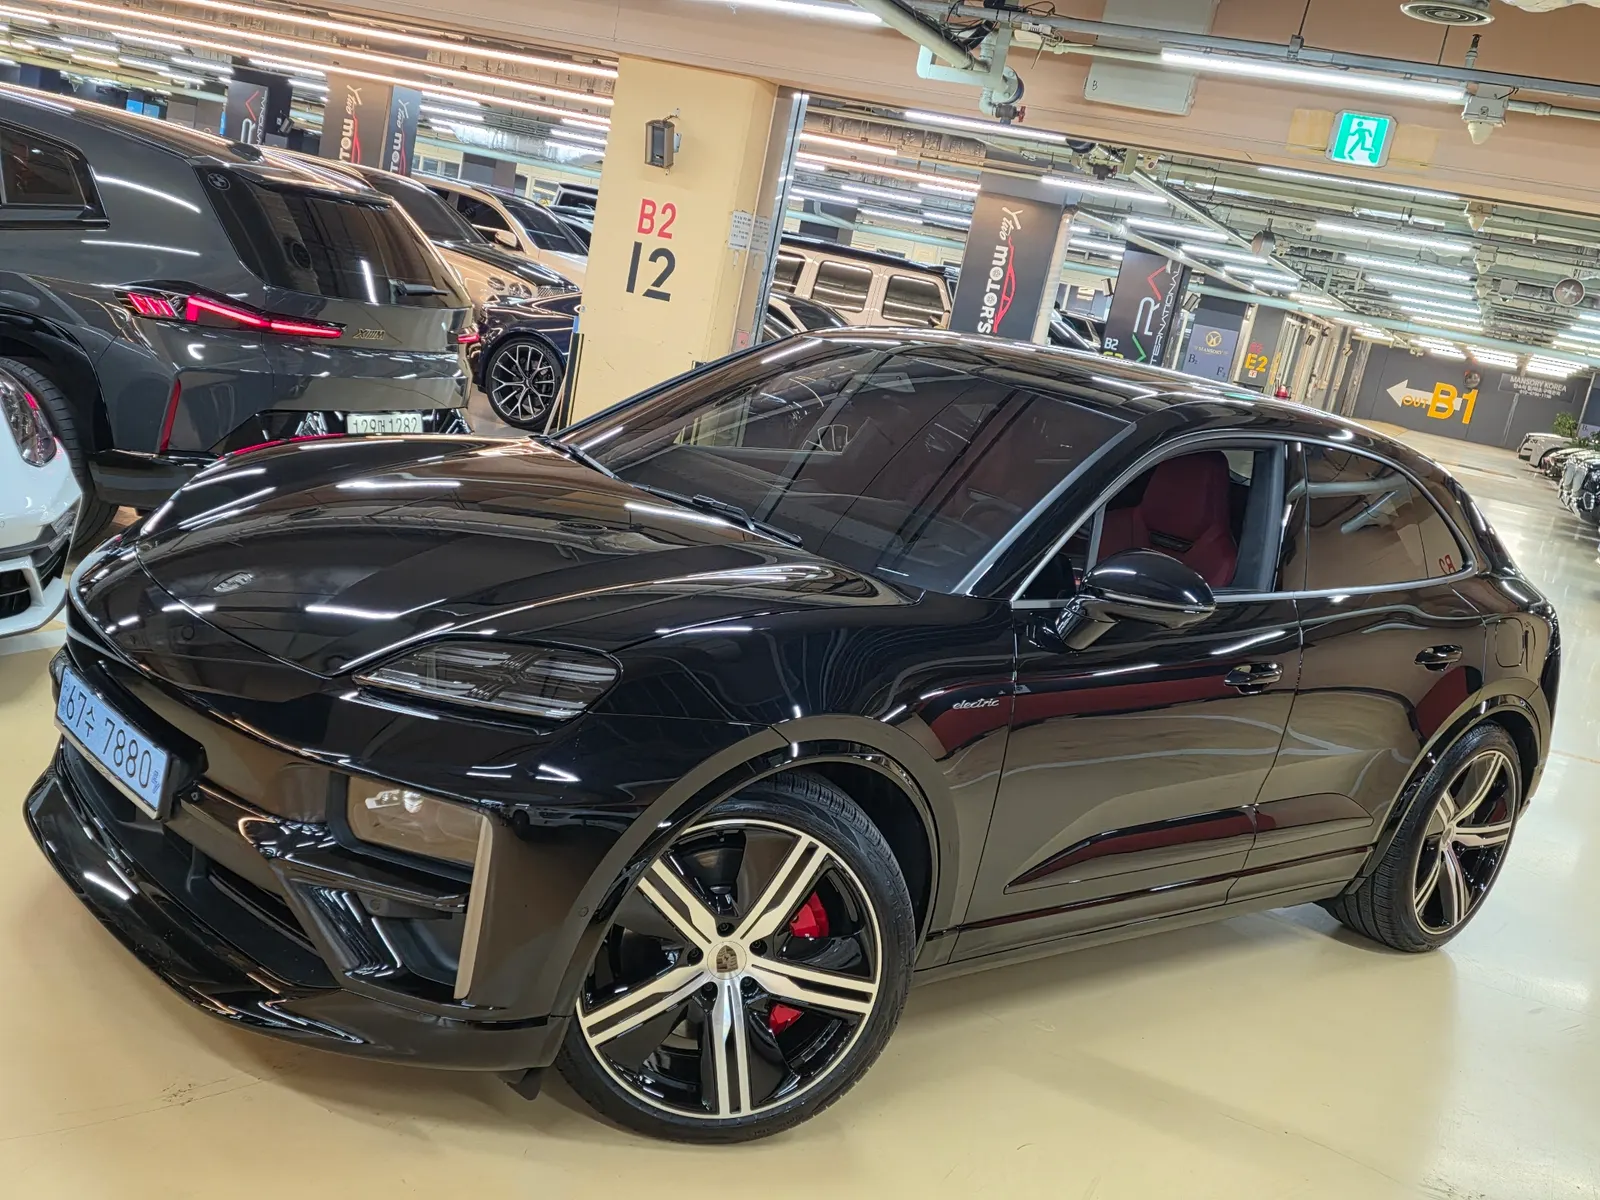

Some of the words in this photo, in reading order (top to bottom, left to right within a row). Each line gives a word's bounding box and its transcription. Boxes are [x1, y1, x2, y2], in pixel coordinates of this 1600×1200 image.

[637, 198, 677, 240] B2
[1103, 337, 1119, 351] B2
[1245, 353, 1268, 373] E2
[1509, 375, 1545, 390] MANSORY
[1543, 380, 1567, 393] KOREA
[1402, 394, 1428, 409] OUT
[1426, 381, 1479, 425] B1
[952, 698, 1000, 710] electric
[66, 685, 96, 738] 67수
[103, 717, 152, 789] 7880
